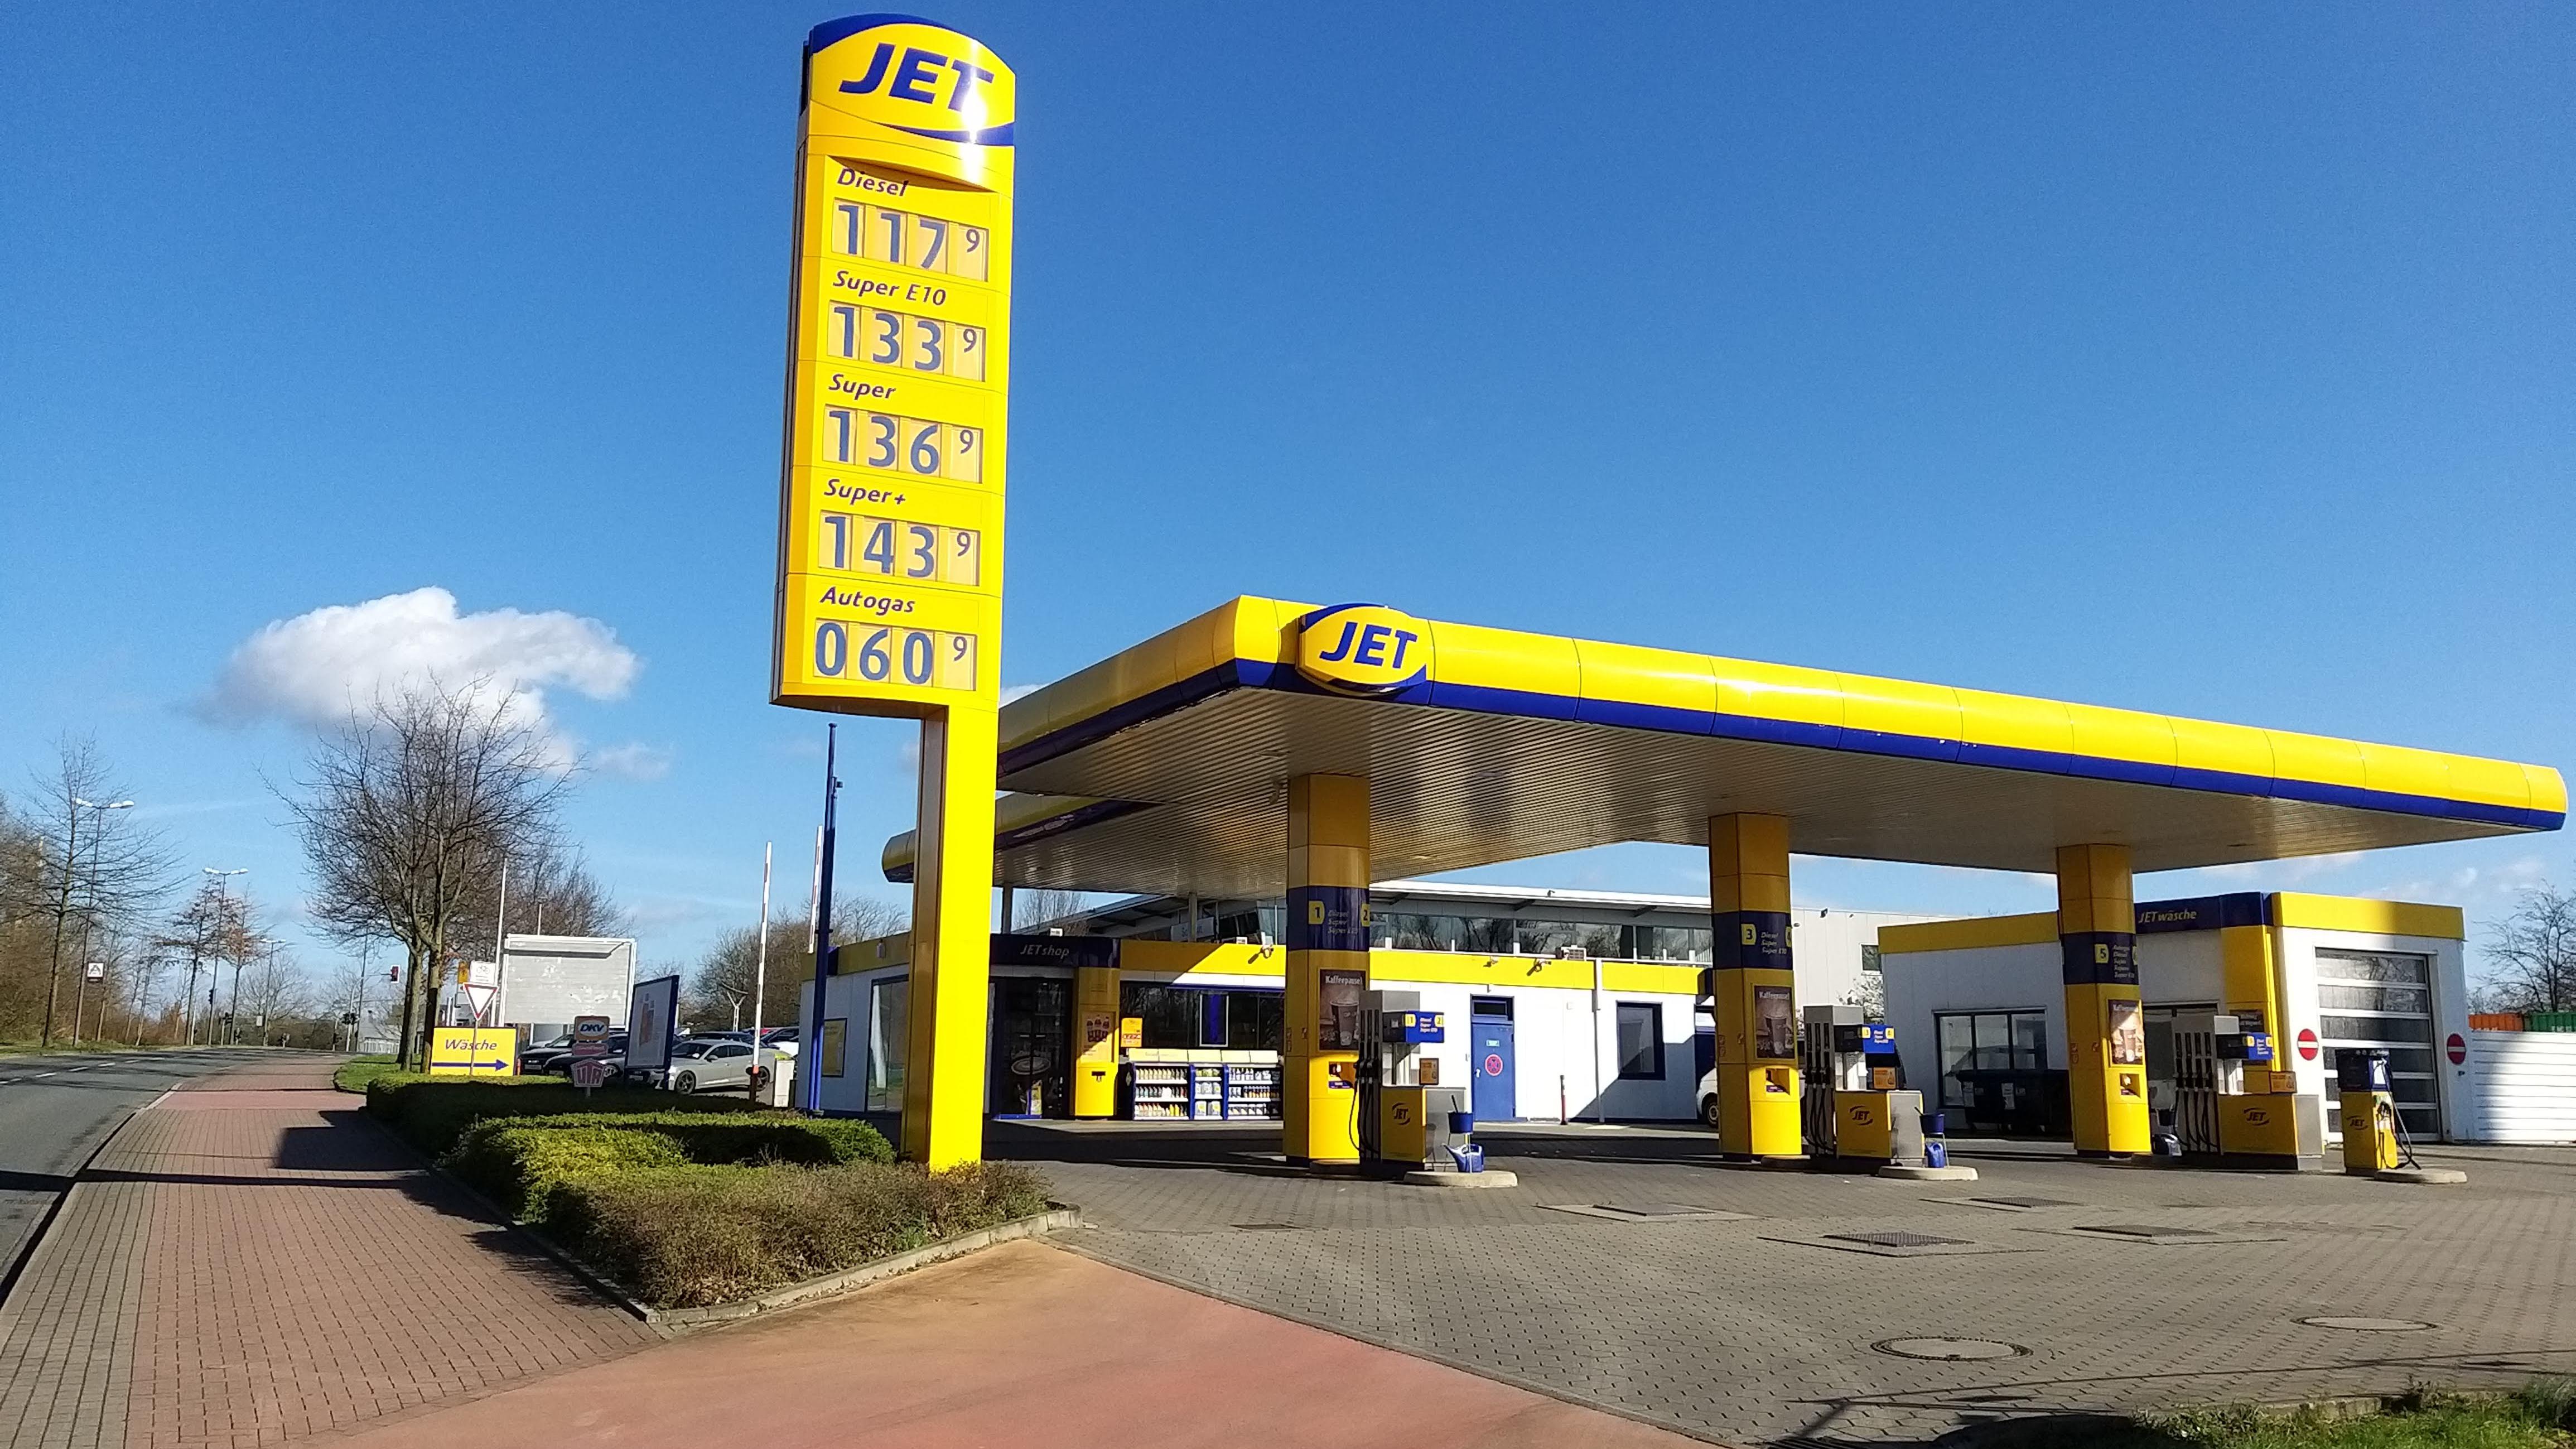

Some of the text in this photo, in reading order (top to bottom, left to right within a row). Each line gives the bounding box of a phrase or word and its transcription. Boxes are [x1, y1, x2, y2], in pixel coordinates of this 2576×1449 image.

[838, 43, 995, 113] JET
[836, 167, 910, 198] Diesel
[832, 271, 947, 306] Super E10
[828, 373, 896, 401] Super
[823, 478, 906, 506] Super+
[819, 586, 916, 616] Autogas
[1319, 621, 1418, 669] JET
[1314, 907, 1320, 919] 1
[1363, 909, 1368, 921] 2
[1746, 928, 1753, 940] 3
[2100, 948, 2106, 959] 5
[580, 1024, 605, 1032] DKV
[445, 1038, 498, 1051] Wäsche
[1393, 1108, 1409, 1120] JET
[1851, 1110, 1870, 1120] JET
[2246, 1111, 2267, 1121] JET
